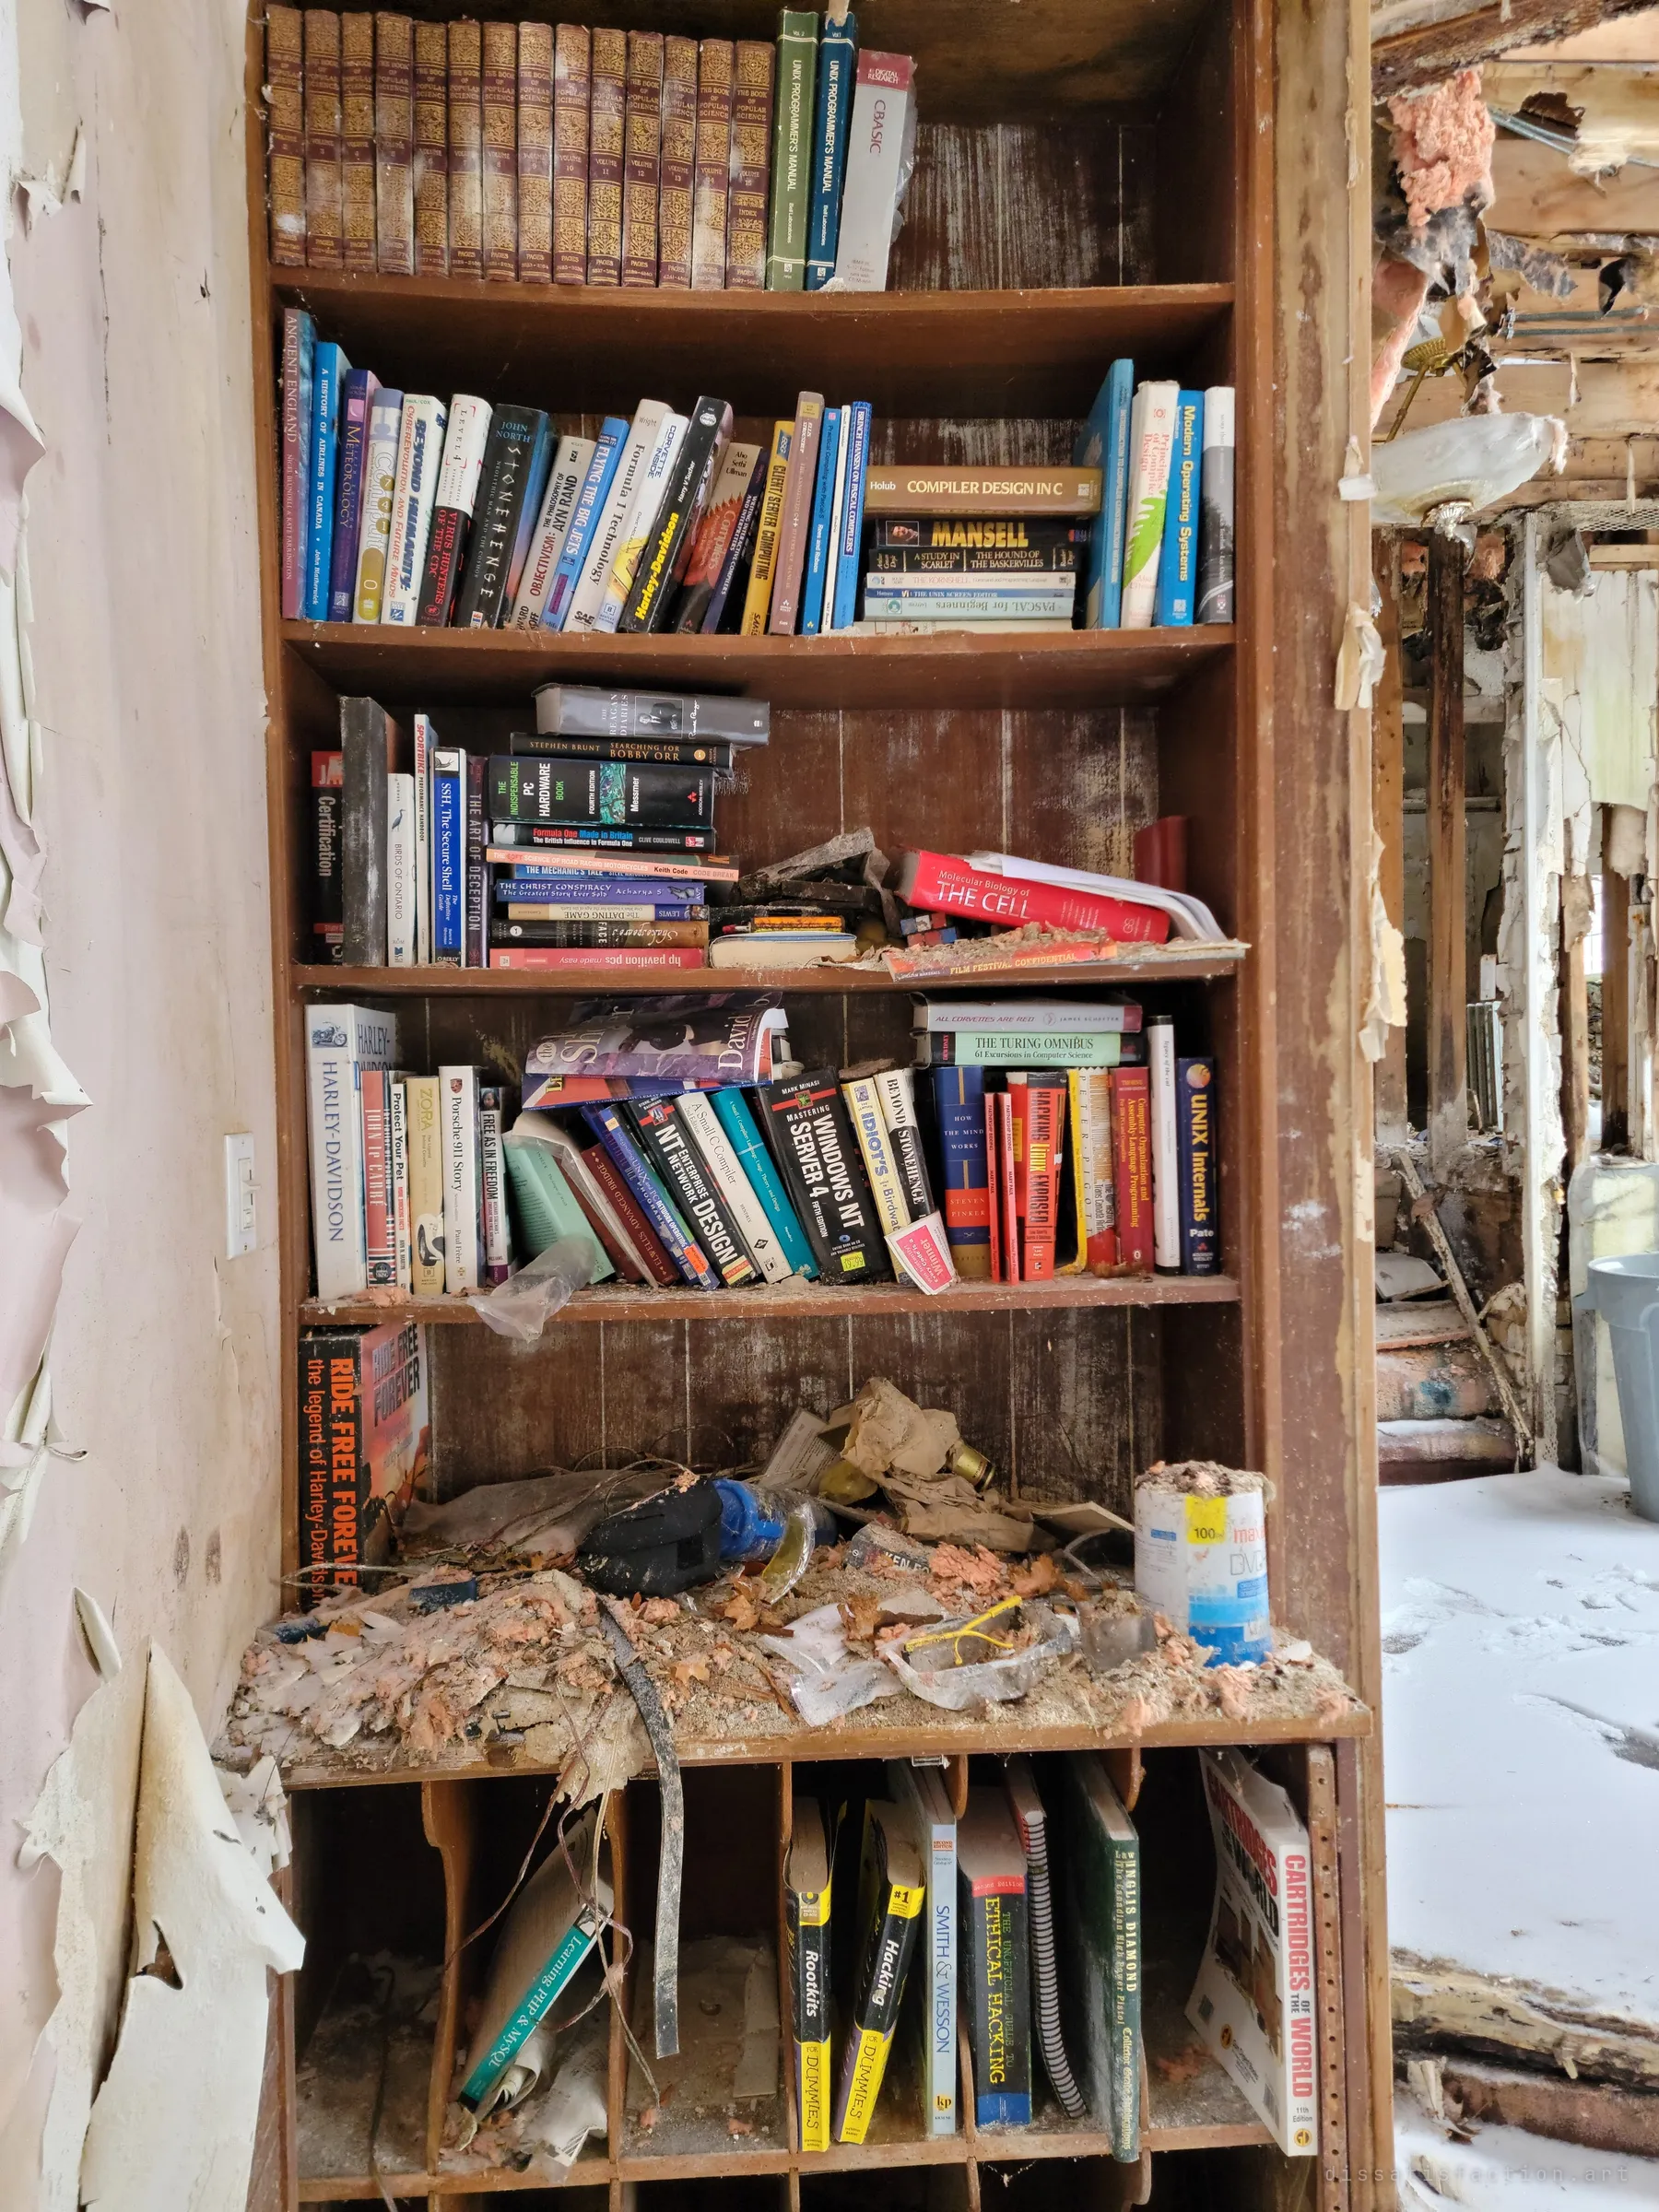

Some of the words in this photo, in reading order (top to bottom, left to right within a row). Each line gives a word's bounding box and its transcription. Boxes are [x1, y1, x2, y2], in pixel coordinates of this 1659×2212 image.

[793, 60, 802, 80] UNIX
[830, 60, 840, 82] UNIX
[868, 74, 900, 84] RESEARCH
[876, 68, 898, 78] DIGITAL
[736, 104, 767, 113] POPULAR
[736, 112, 767, 122] SCIENCE
[790, 83, 801, 153] PROGRAMMER'S
[825, 84, 838, 154] PROGRAMMER'S
[870, 99, 887, 155] CBASIC
[630, 159, 653, 168] VOLUME
[787, 155, 798, 192] MANUAL
[823, 157, 834, 194] MANUAL
[739, 209, 758, 218] INDEX
[286, 315, 298, 375] ANCIENT
[284, 378, 298, 443] ENGLAND
[320, 422, 327, 434] OF
[496, 429, 532, 444] NORTH
[500, 421, 529, 432] JOHN
[1182, 406, 1196, 456] Modern
[318, 439, 326, 477] AIRLINES
[592, 445, 611, 484] FLYING
[647, 446, 660, 479] INSIDE
[654, 424, 677, 478] CORVETTE
[732, 459, 747, 468] Sethi
[735, 451, 748, 459] Aho
[725, 467, 747, 477] Ullman
[870, 481, 896, 491] Holub
[317, 482, 324, 491] IN
[582, 485, 598, 506] THE
[768, 465, 786, 528] CLIENT/SERVER
[907, 480, 980, 496] COMPILER
[982, 481, 1034, 496] DESIGN
[1036, 482, 1052, 496] IN
[1053, 482, 1064, 496] C
[1178, 459, 1194, 523] Operating
[315, 496, 324, 530] CANADA
[552, 503, 567, 533] AYN
[562, 475, 578, 505] RAND
[573, 507, 591, 527] BIG
[442, 512, 458, 549] VIRUS
[566, 525, 584, 557] JETS
[931, 521, 1029, 548] MANSELL
[634, 512, 680, 621] Harley-Davidson
[754, 529, 776, 582] COMPUTING
[920, 560, 955, 570] SCARLET
[970, 560, 986, 569] THE
[986, 559, 1044, 569] BASKERVILLES
[975, 551, 991, 560] THE
[991, 551, 1025, 560] HOUND
[1027, 551, 1040, 560] OF
[1178, 525, 1193, 582] Systems
[435, 551, 452, 606] HUNTERS
[936, 599, 988, 612] Beginners
[992, 601, 1008, 612] for
[1013, 601, 1056, 612] PASCAL
[417, 724, 426, 774] SPORTBIKE
[529, 741, 570, 751] STEPHEN
[571, 743, 601, 752] BRUNT
[610, 742, 662, 752] SEARCHING
[663, 744, 680, 752] FOR
[610, 748, 649, 759] BOBBY
[654, 750, 680, 761] ORR
[441, 782, 452, 807] SSH,
[510, 761, 519, 816] INDISPENSABLE
[539, 763, 551, 817] HARDWARE
[441, 810, 452, 830] The
[318, 795, 336, 877] Certification
[442, 830, 452, 865] Secure
[533, 828, 562, 839] Formula
[564, 830, 578, 839] One
[579, 830, 599, 839] Made
[600, 830, 608, 840] in
[608, 831, 633, 841] Britain
[394, 843, 403, 866] BIRDS
[394, 868, 403, 879] OF
[442, 866, 453, 890] Shell
[555, 883, 612, 892] CONSPIRACY
[938, 870, 982, 887] Molecular
[984, 879, 1018, 895] Biology
[1019, 888, 1030, 898] of
[394, 881, 403, 920] ONTARIO
[936, 879, 977, 908] THE
[981, 891, 1030, 920] CELL
[559, 957, 579, 965] easy
[580, 957, 602, 965] made
[605, 957, 624, 966] pcs
[625, 955, 665, 966] pavilion
[665, 955, 682, 966] hp
[975, 1037, 997, 1049] THE
[999, 1037, 1041, 1049] TURING
[1043, 1036, 1094, 1049] OMNIBUS
[984, 1051, 1023, 1059] Excursions
[1023, 1051, 1031, 1059] in
[1032, 1051, 1067, 1060] Computer
[1067, 1051, 1094, 1059] Science
[782, 1086, 799, 1095] MARK
[799, 1079, 820, 1090] MINASI
[394, 1093, 402, 1132] Protect
[452, 1097, 463, 1140] Porsche
[483, 1113, 496, 1135] FREE
[1191, 1094, 1209, 1146] UNIX
[323, 1062, 345, 1242] HARLEY-DAVIDSON
[394, 1135, 404, 1159] Your
[453, 1141, 463, 1159] 911
[485, 1136, 496, 1147] AS
[485, 1149, 497, 1159] IN
[887, 1078, 907, 1124] BEYOND
[898, 1130, 925, 1206] STONEHENGE
[396, 1161, 405, 1181] Pet
[452, 1161, 464, 1193] Story
[485, 1161, 499, 1200] FREEDOM
[678, 1148, 710, 1200] ENTERPRISE
[813, 1113, 855, 1203] WINDOWS
[837, 1202, 865, 1230] NT
[1191, 1152, 1209, 1223] Internals
[692, 1198, 738, 1265] DESIGN
[330, 1358, 355, 1414] RIDE
[332, 1421, 356, 1484] FREE
[1194, 1528, 1216, 1539] 100
[1125, 1860, 1137, 1920] INGLIS
[936, 1905, 950, 1959] SMITH
[1285, 1854, 1311, 1991] CARTRIDGES
[984, 1896, 1001, 1987] ETHICAL
[542, 1936, 582, 1988] Learning
[936, 1961, 948, 1980] &
[1125, 1923, 1137, 1993] DIAMOND
[806, 1950, 820, 2018] Rootkits
[527, 1987, 547, 2016] PHP
[516, 2015, 529, 2026] &
[936, 1983, 950, 2054] WESSON
[488, 2028, 522, 2068] MySQL
[988, 1992, 1006, 2085] HACKING
[1290, 2017, 1312, 2098] WORLD
[806, 2057, 819, 2130] DUMMIES
[1292, 2114, 1312, 2123] Edition
